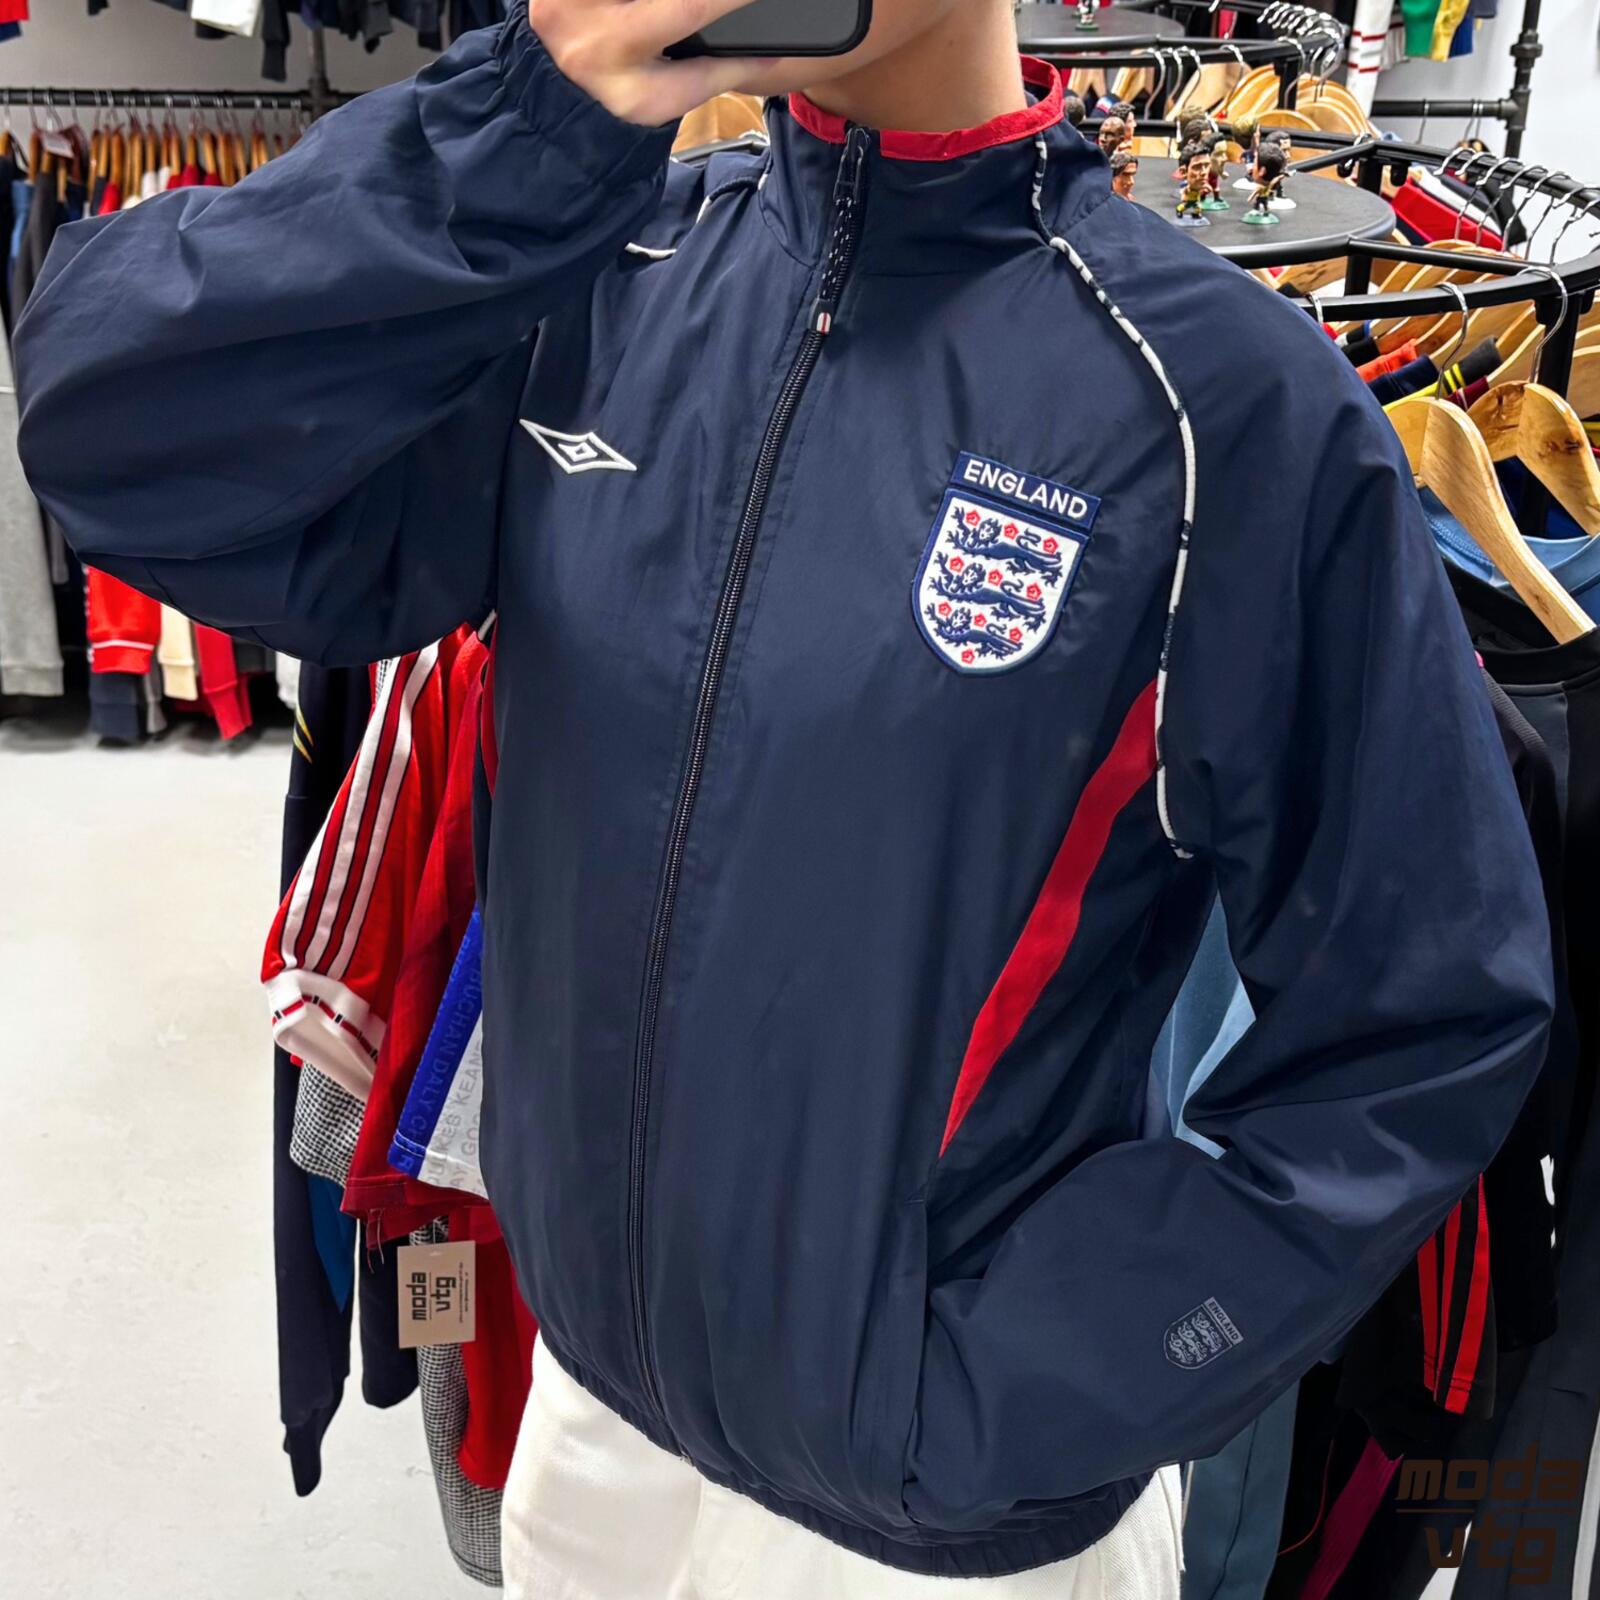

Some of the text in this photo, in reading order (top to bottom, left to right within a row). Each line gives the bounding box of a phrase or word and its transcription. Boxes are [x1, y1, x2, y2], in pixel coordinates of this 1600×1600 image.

[963, 458, 1088, 519] ENGLAND
[418, 1058, 451, 1113] DALY
[405, 1272, 428, 1321] moda
[430, 1276, 457, 1312] vtg
[1208, 1301, 1240, 1341] ENGLAND
